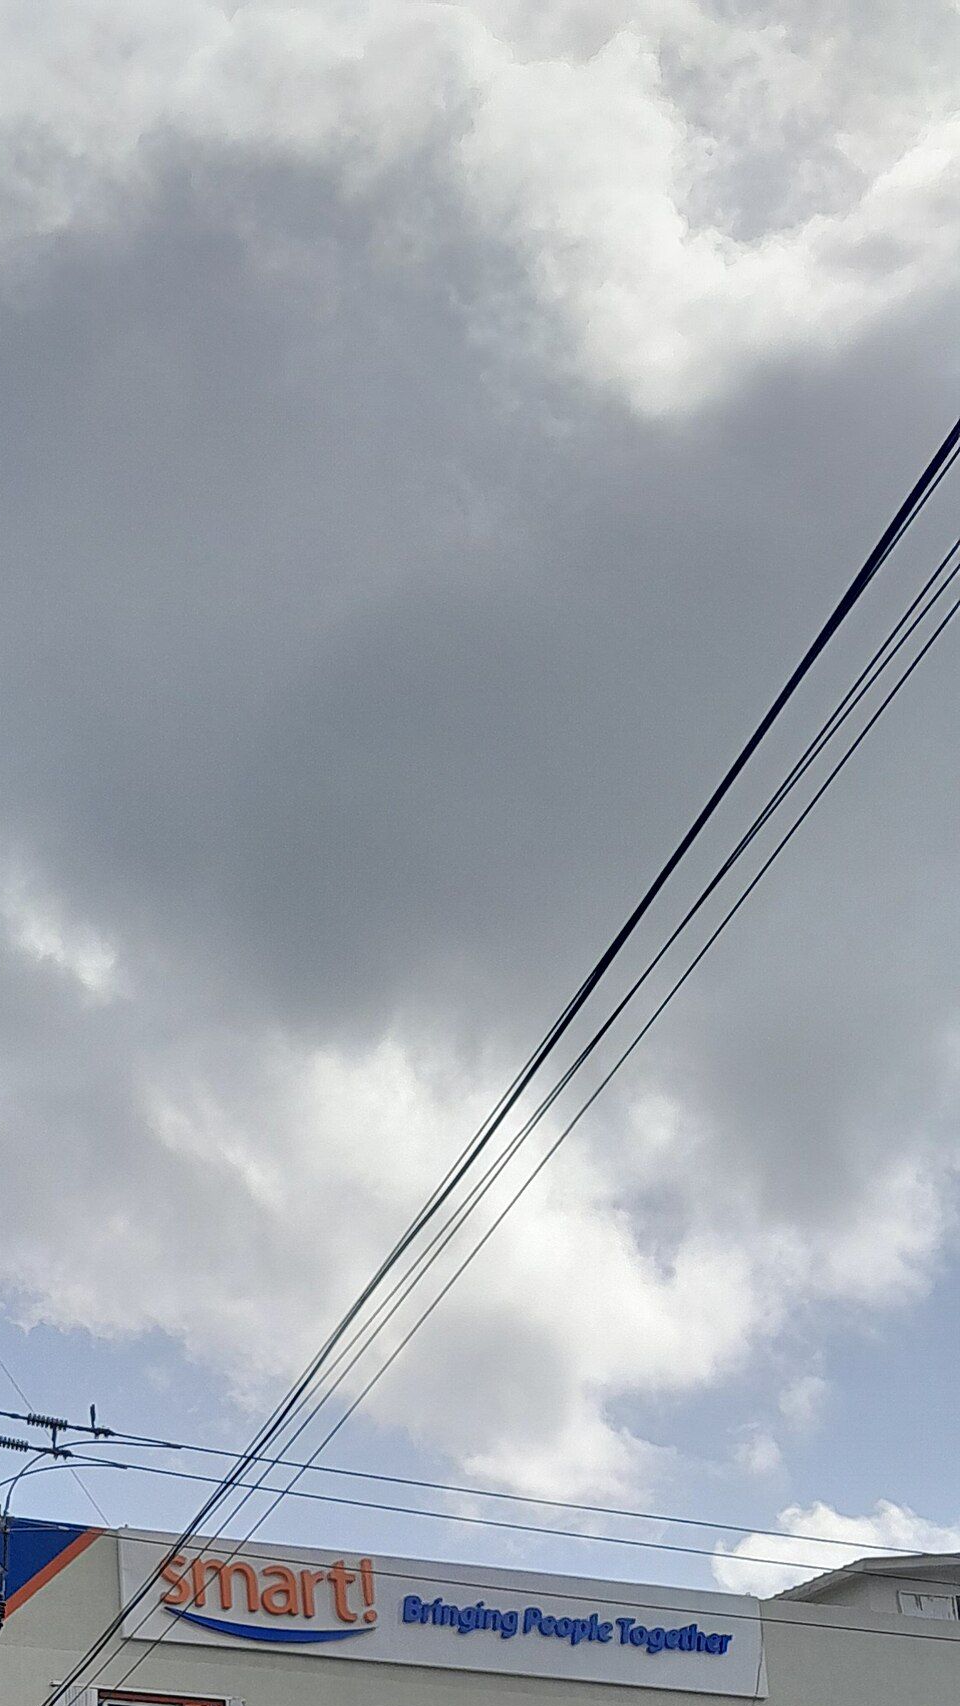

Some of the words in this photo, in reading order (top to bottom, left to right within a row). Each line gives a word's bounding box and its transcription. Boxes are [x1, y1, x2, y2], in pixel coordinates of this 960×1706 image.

[159, 1554, 378, 1623] smart!
[402, 1595, 519, 1639] Bringing
[522, 1607, 614, 1646] People
[615, 1617, 733, 1655] Together
